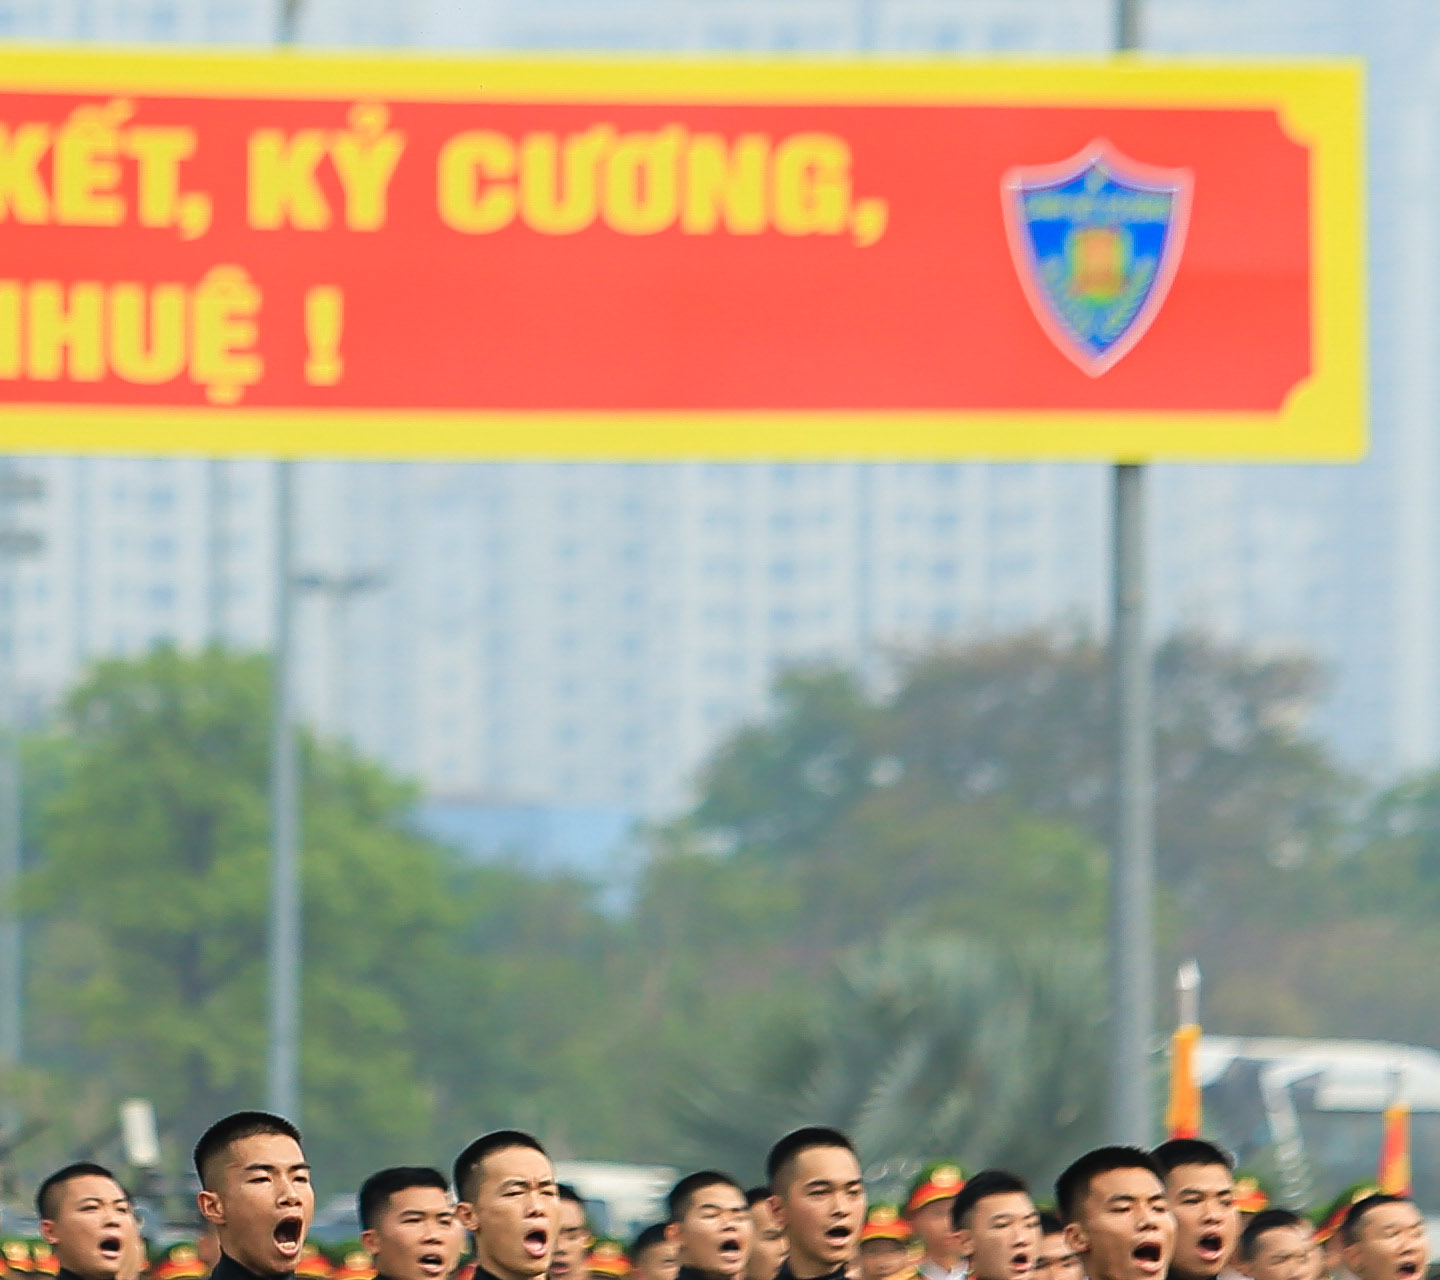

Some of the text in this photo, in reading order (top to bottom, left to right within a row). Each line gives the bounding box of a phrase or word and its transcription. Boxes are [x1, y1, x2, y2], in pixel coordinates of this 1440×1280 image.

[246, 102, 404, 231] KỶ
[437, 124, 888, 246] CƯƠNG,
[305, 287, 343, 385] !
